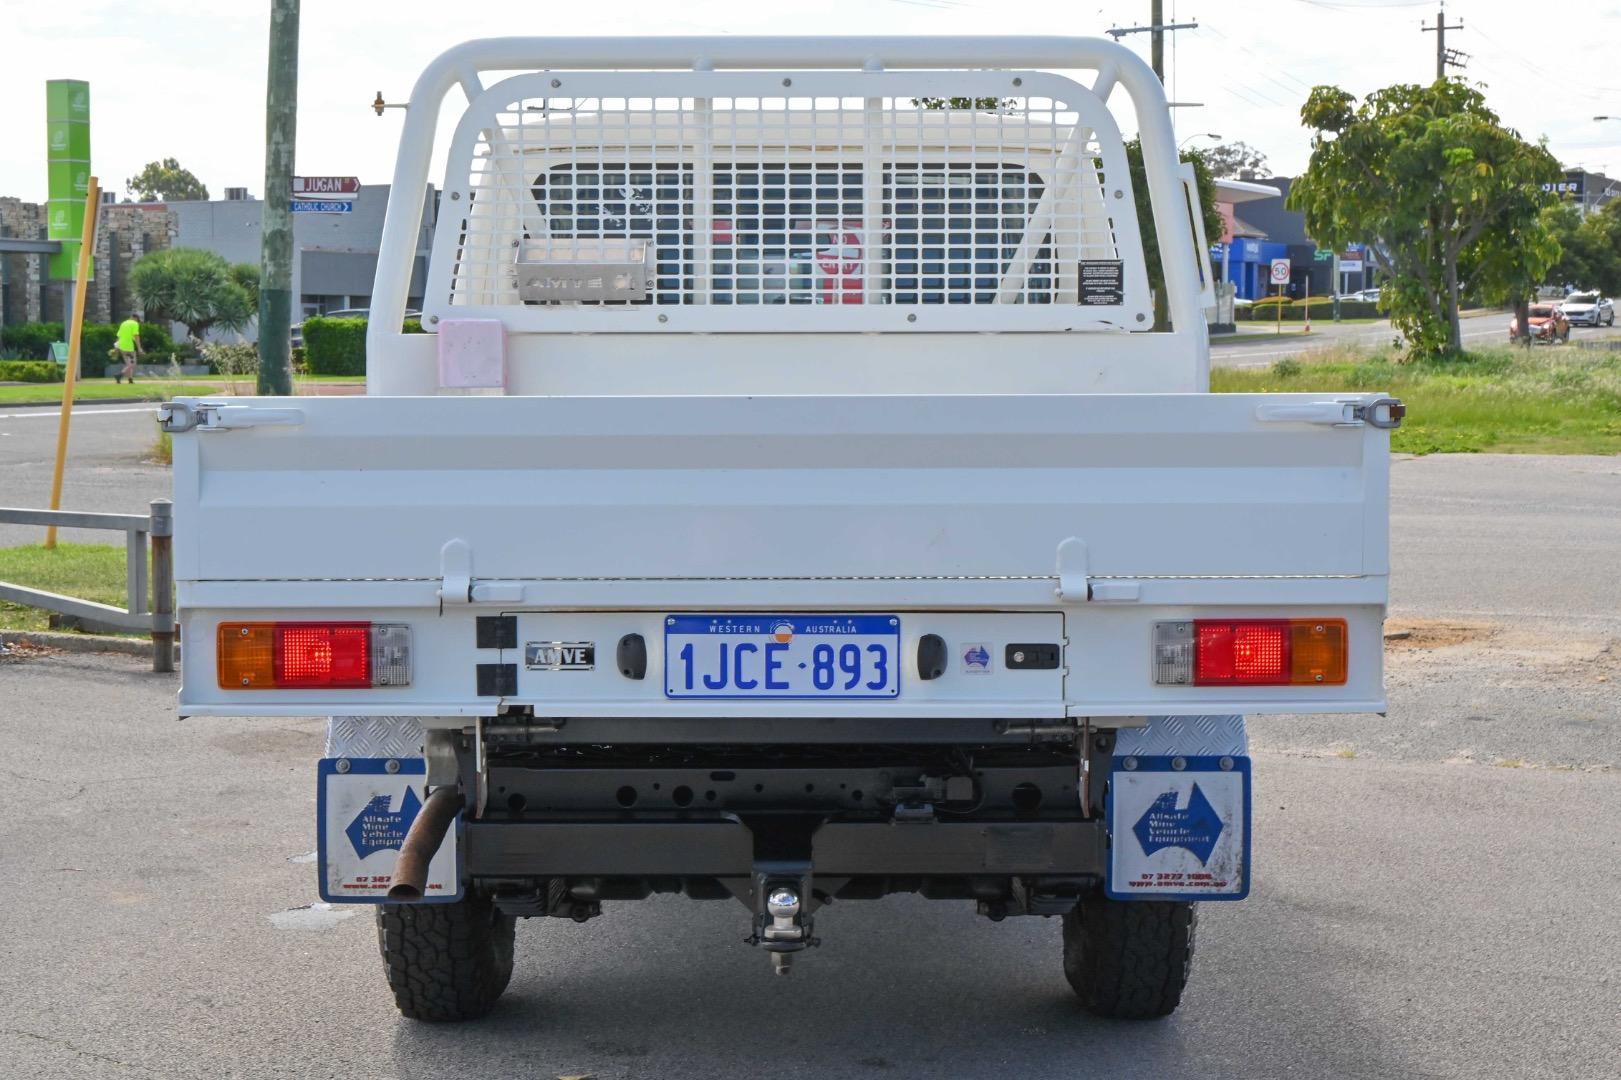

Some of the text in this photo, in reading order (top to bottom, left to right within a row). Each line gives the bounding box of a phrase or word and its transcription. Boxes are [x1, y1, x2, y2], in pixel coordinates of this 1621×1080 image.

[306, 178, 342, 192] JUGAN
[294, 202, 342, 211] CATHOLIC CHURCH
[1274, 267, 1287, 276] 50
[709, 625, 857, 633] WESTERN AUSTRALIA
[534, 649, 587, 664] AMVE
[362, 830, 403, 838] Vehicle
